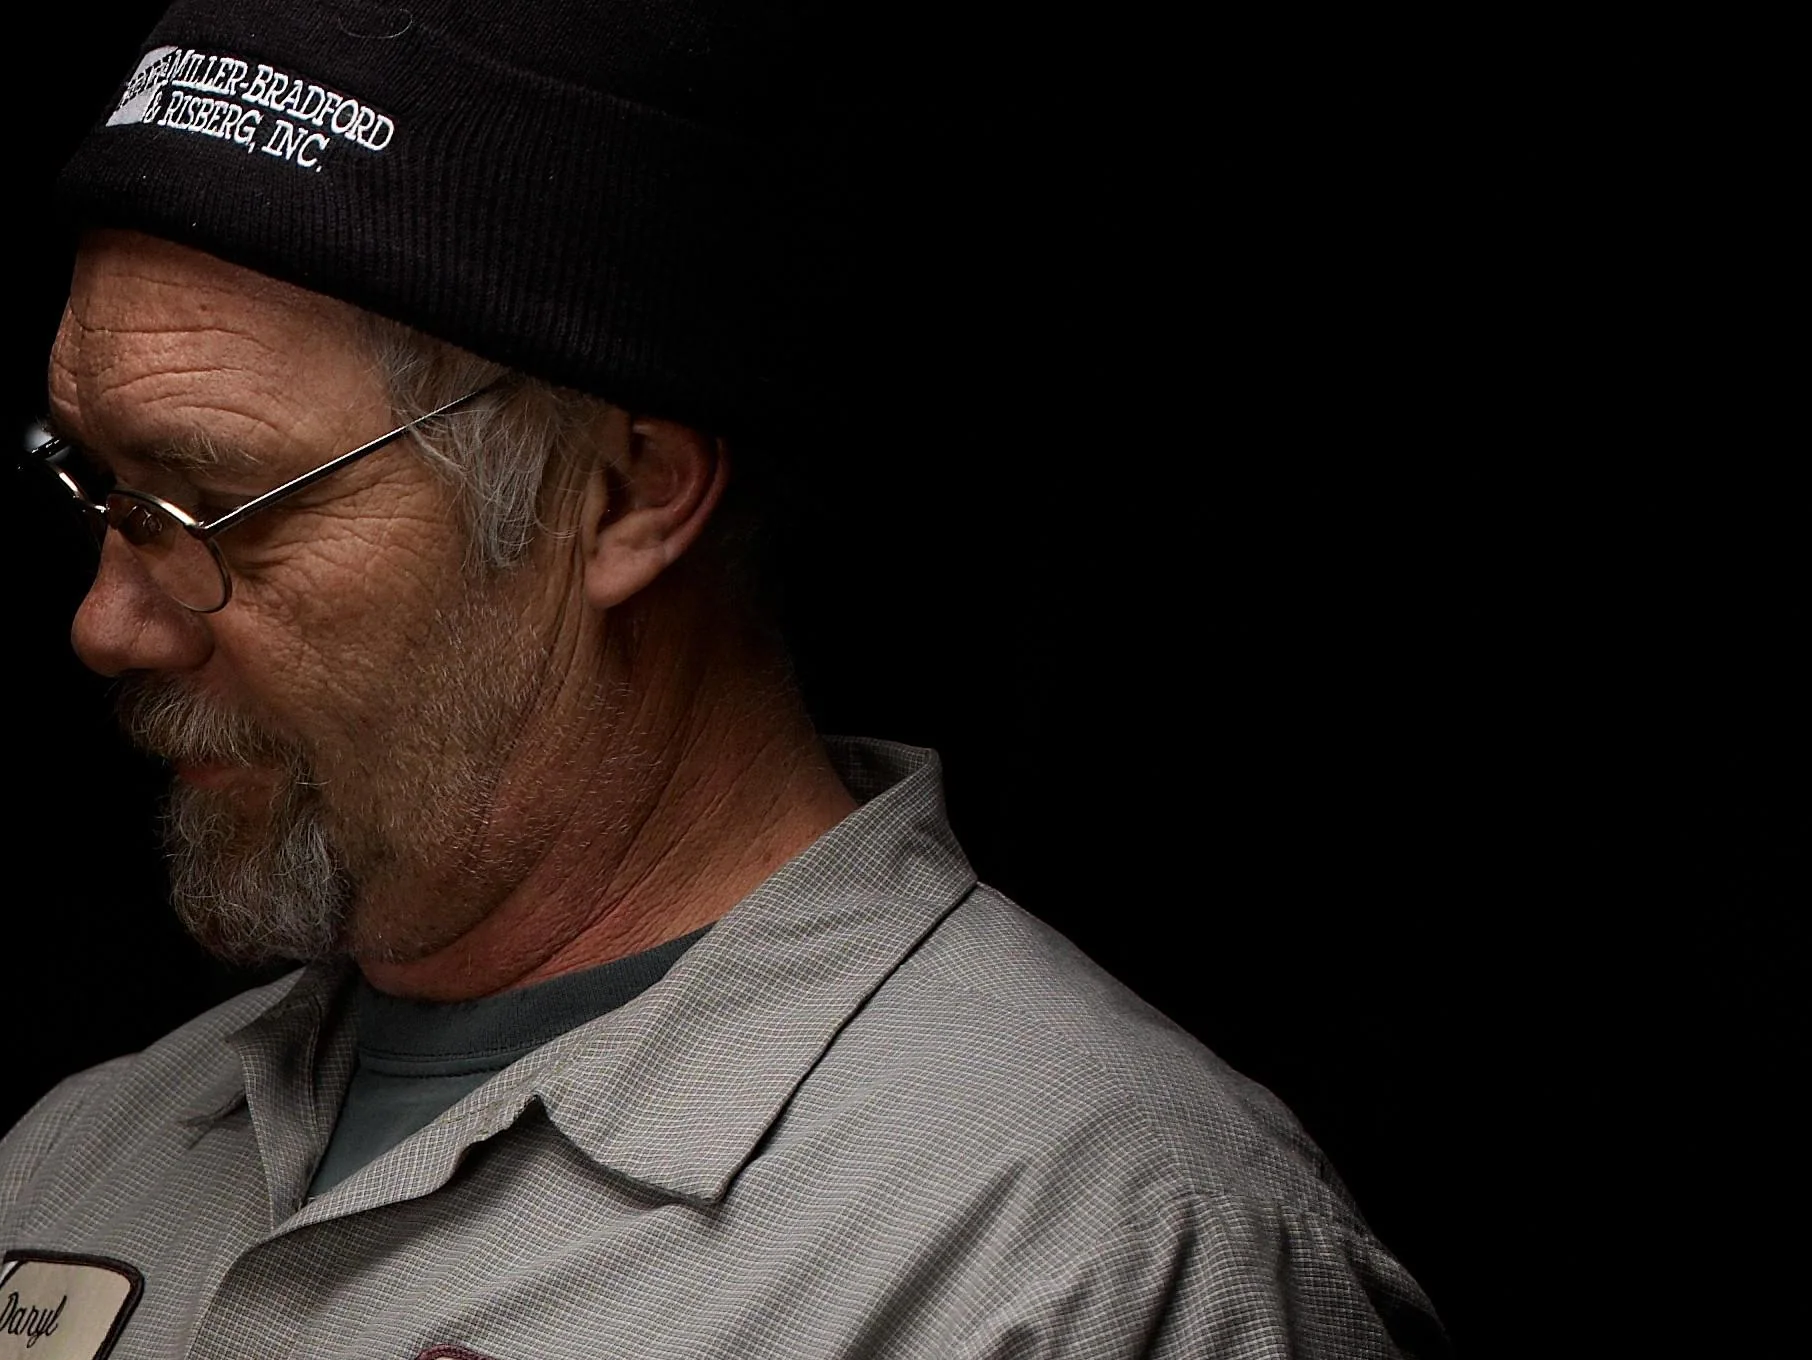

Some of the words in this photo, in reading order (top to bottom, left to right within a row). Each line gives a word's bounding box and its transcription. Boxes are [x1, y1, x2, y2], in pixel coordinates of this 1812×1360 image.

[142, 91, 164, 124] &
[158, 91, 264, 154] RISBERG,
[262, 119, 330, 172] INC.
[172, 49, 395, 151] MILLER-BRADFORD
